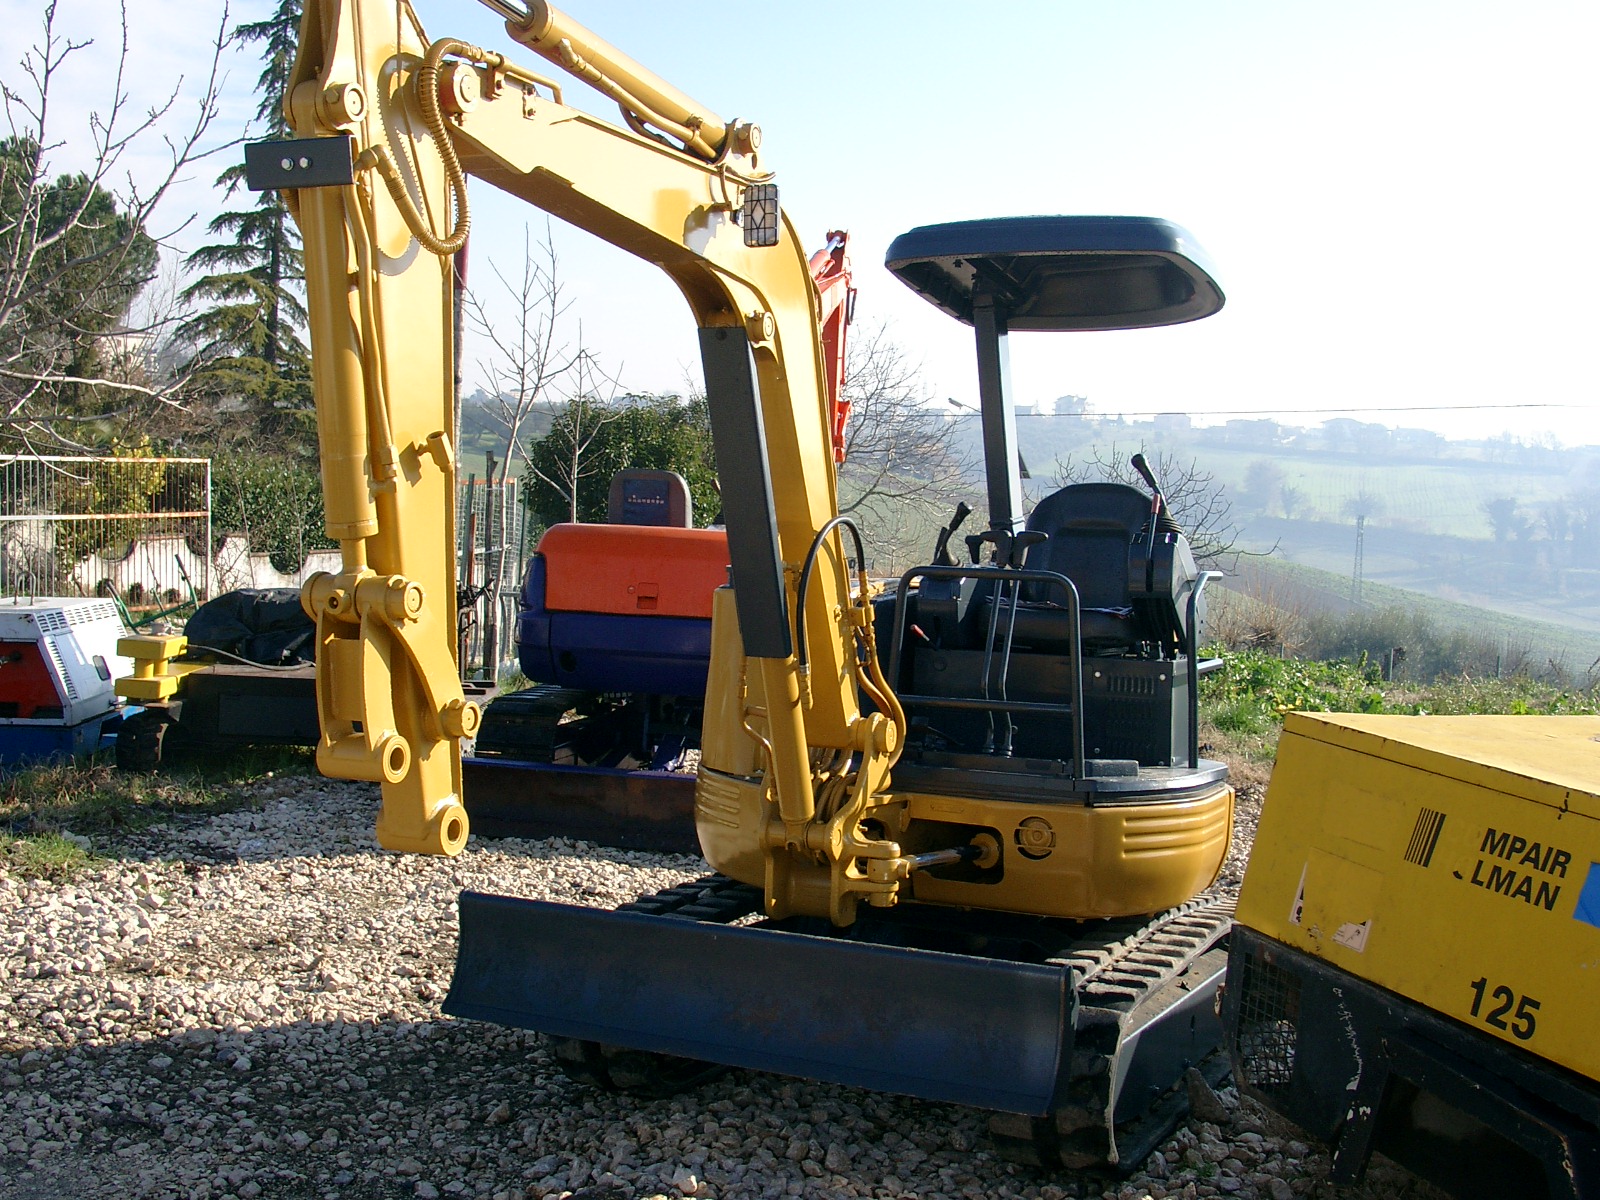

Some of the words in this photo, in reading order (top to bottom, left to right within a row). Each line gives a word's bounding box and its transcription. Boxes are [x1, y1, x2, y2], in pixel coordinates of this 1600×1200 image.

[1480, 828, 1572, 878] MPAIR
[1453, 860, 1561, 911] LMAN
[1470, 977, 1541, 1040] 125
